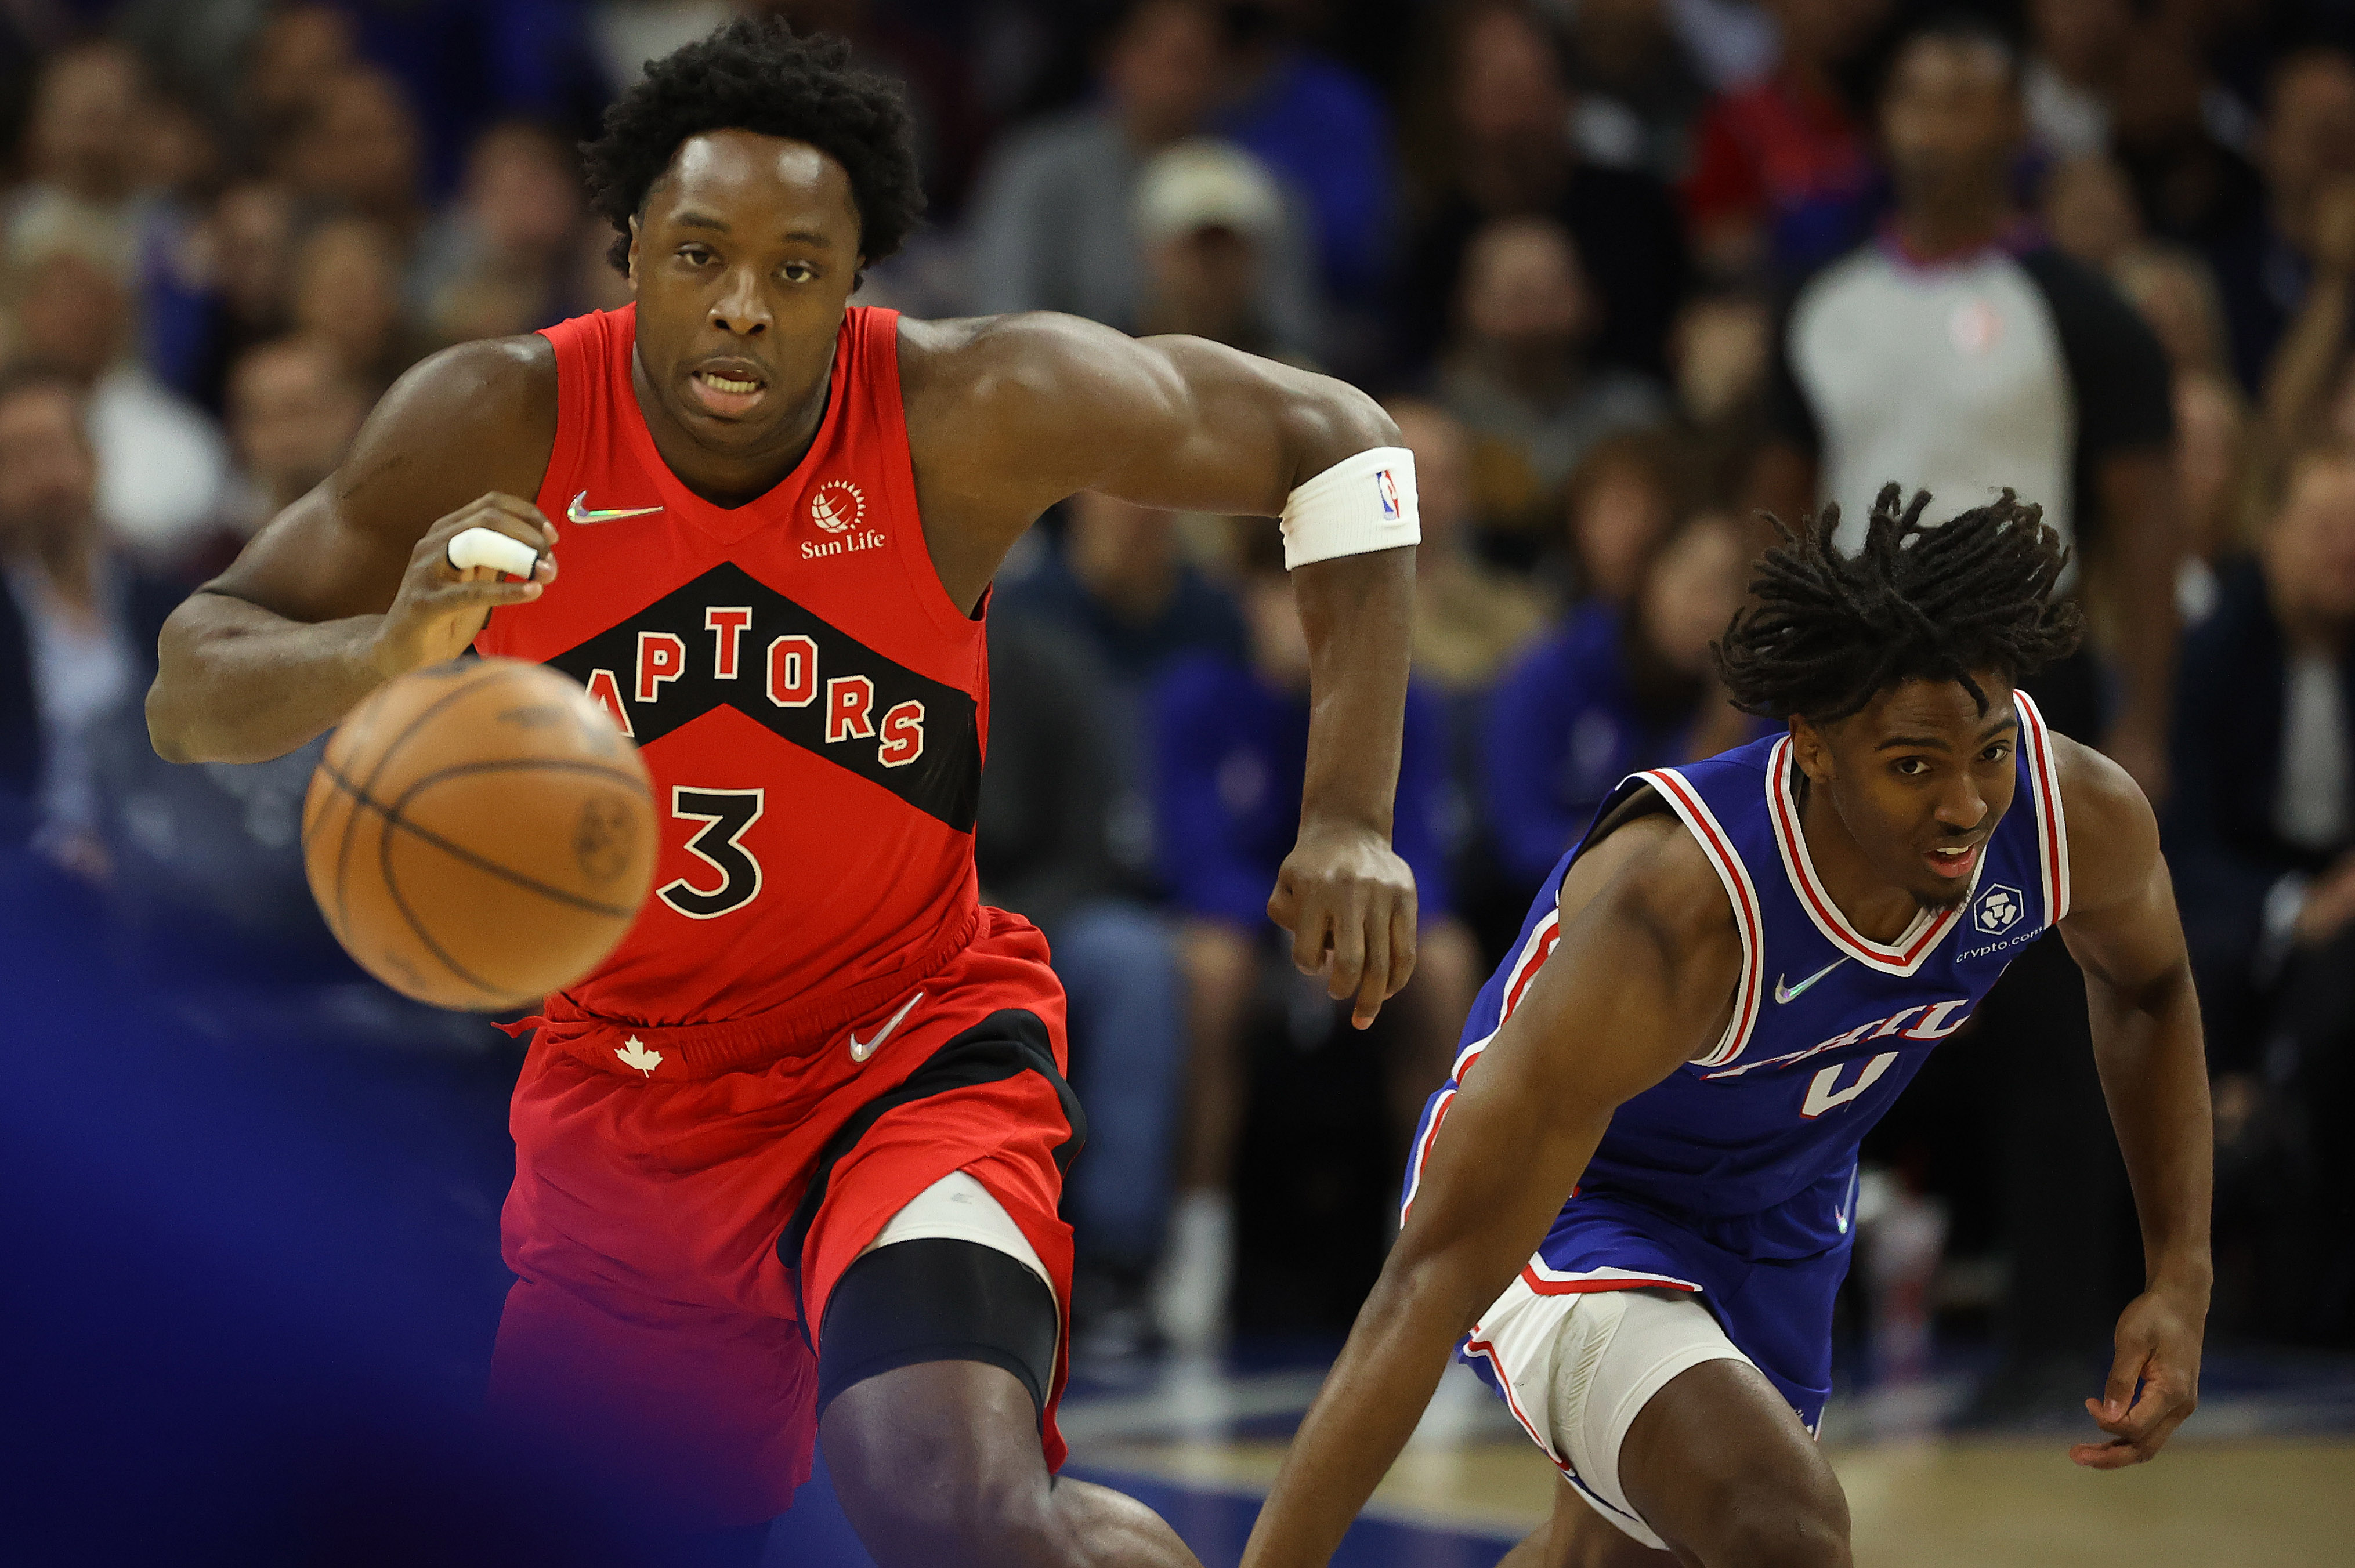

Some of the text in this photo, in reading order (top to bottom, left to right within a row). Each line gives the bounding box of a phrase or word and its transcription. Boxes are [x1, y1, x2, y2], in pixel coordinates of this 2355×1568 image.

[801, 528, 885, 560] Sun Life
[585, 606, 925, 769] APTORS
[656, 785, 765, 920] 3
